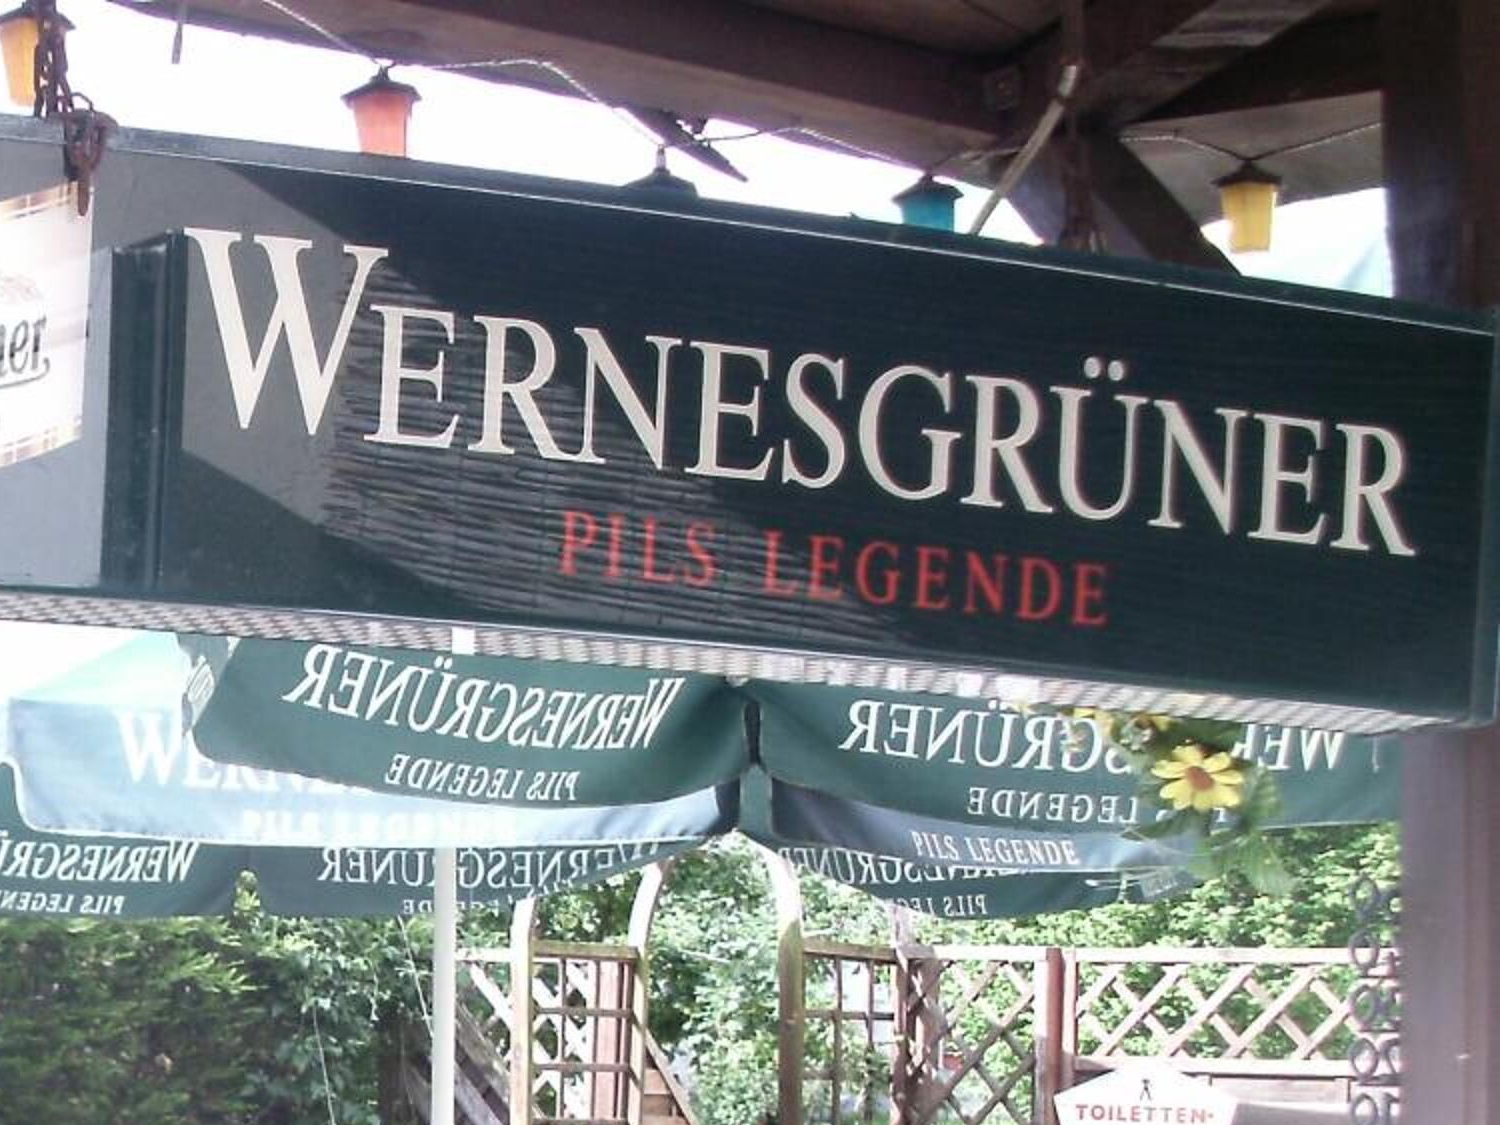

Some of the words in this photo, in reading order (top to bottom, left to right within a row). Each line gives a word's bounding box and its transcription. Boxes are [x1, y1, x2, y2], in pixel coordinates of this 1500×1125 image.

[183, 226, 1417, 558] WERNESGRÜNER
[559, 511, 722, 588] PILS
[763, 528, 1110, 627] LEGENDE
[911, 830, 959, 860] PILS
[966, 836, 1079, 866] LEGENDE
